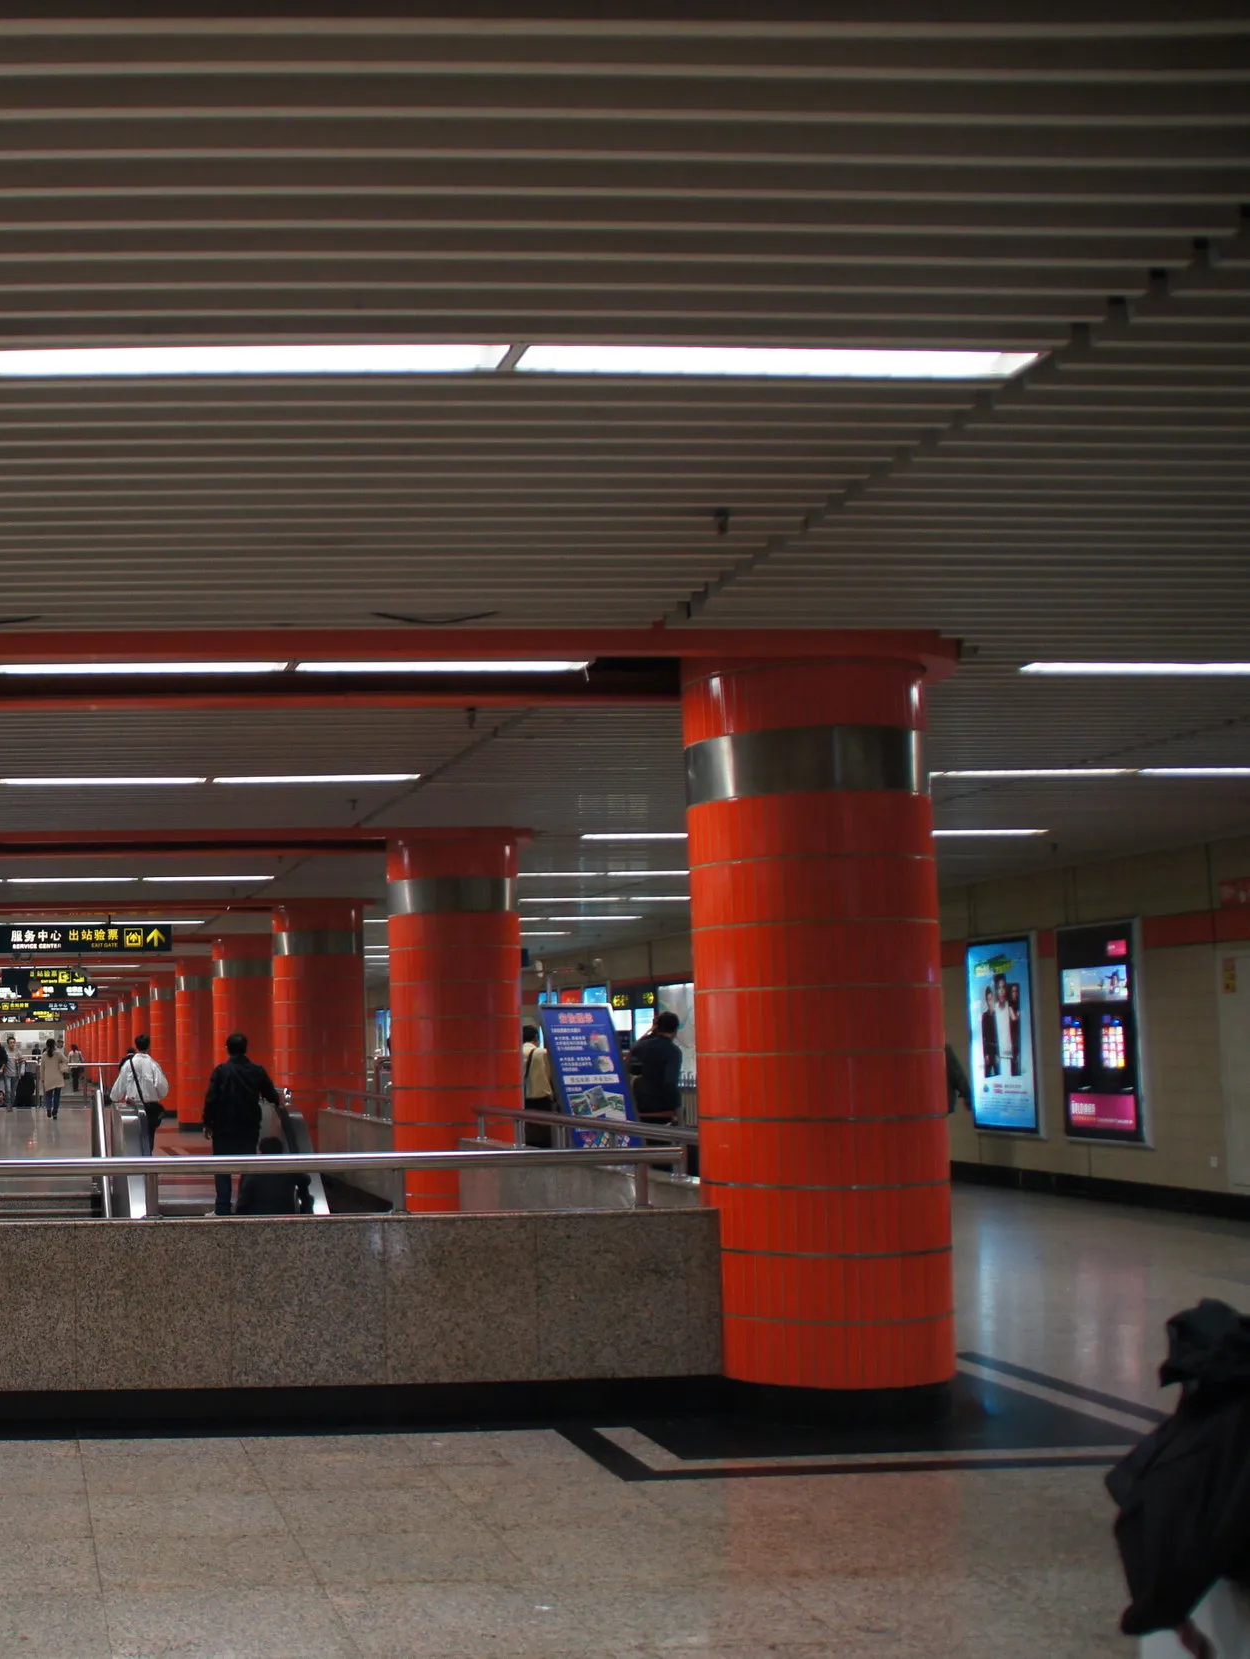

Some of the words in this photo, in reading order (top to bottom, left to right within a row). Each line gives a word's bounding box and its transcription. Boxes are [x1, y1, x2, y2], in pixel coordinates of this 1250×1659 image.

[11, 929, 62, 942] 服务中心
[68, 928, 119, 941] 出站验票
